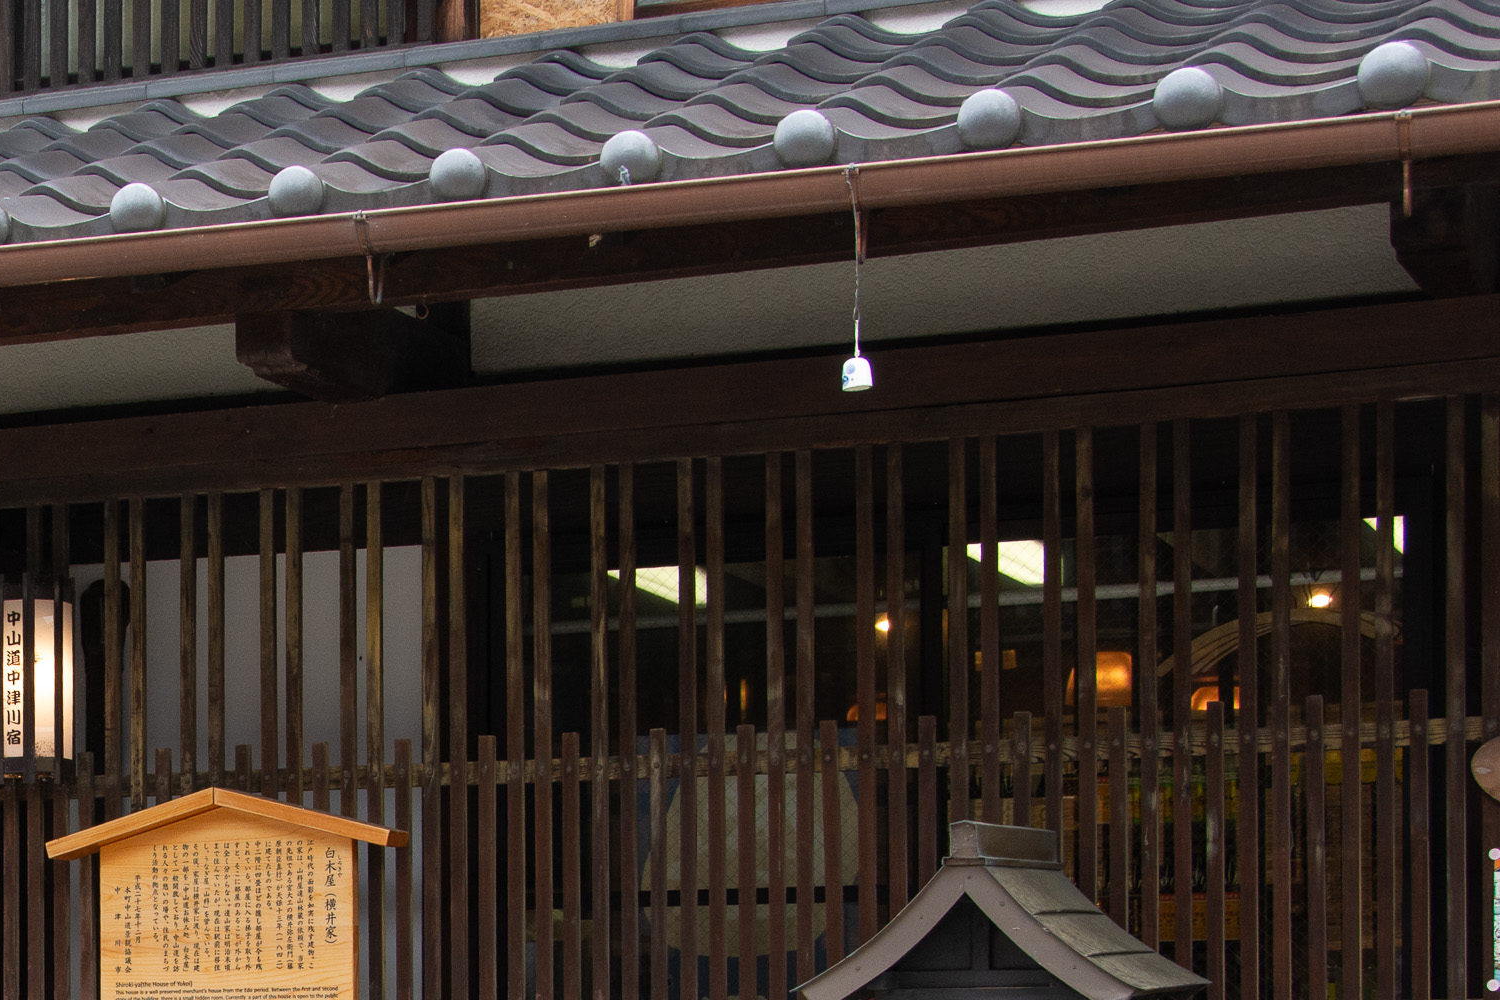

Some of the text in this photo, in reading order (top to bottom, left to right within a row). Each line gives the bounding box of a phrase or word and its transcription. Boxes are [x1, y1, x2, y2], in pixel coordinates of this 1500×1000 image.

[6, 610, 22, 746] 中山道中津川宿
